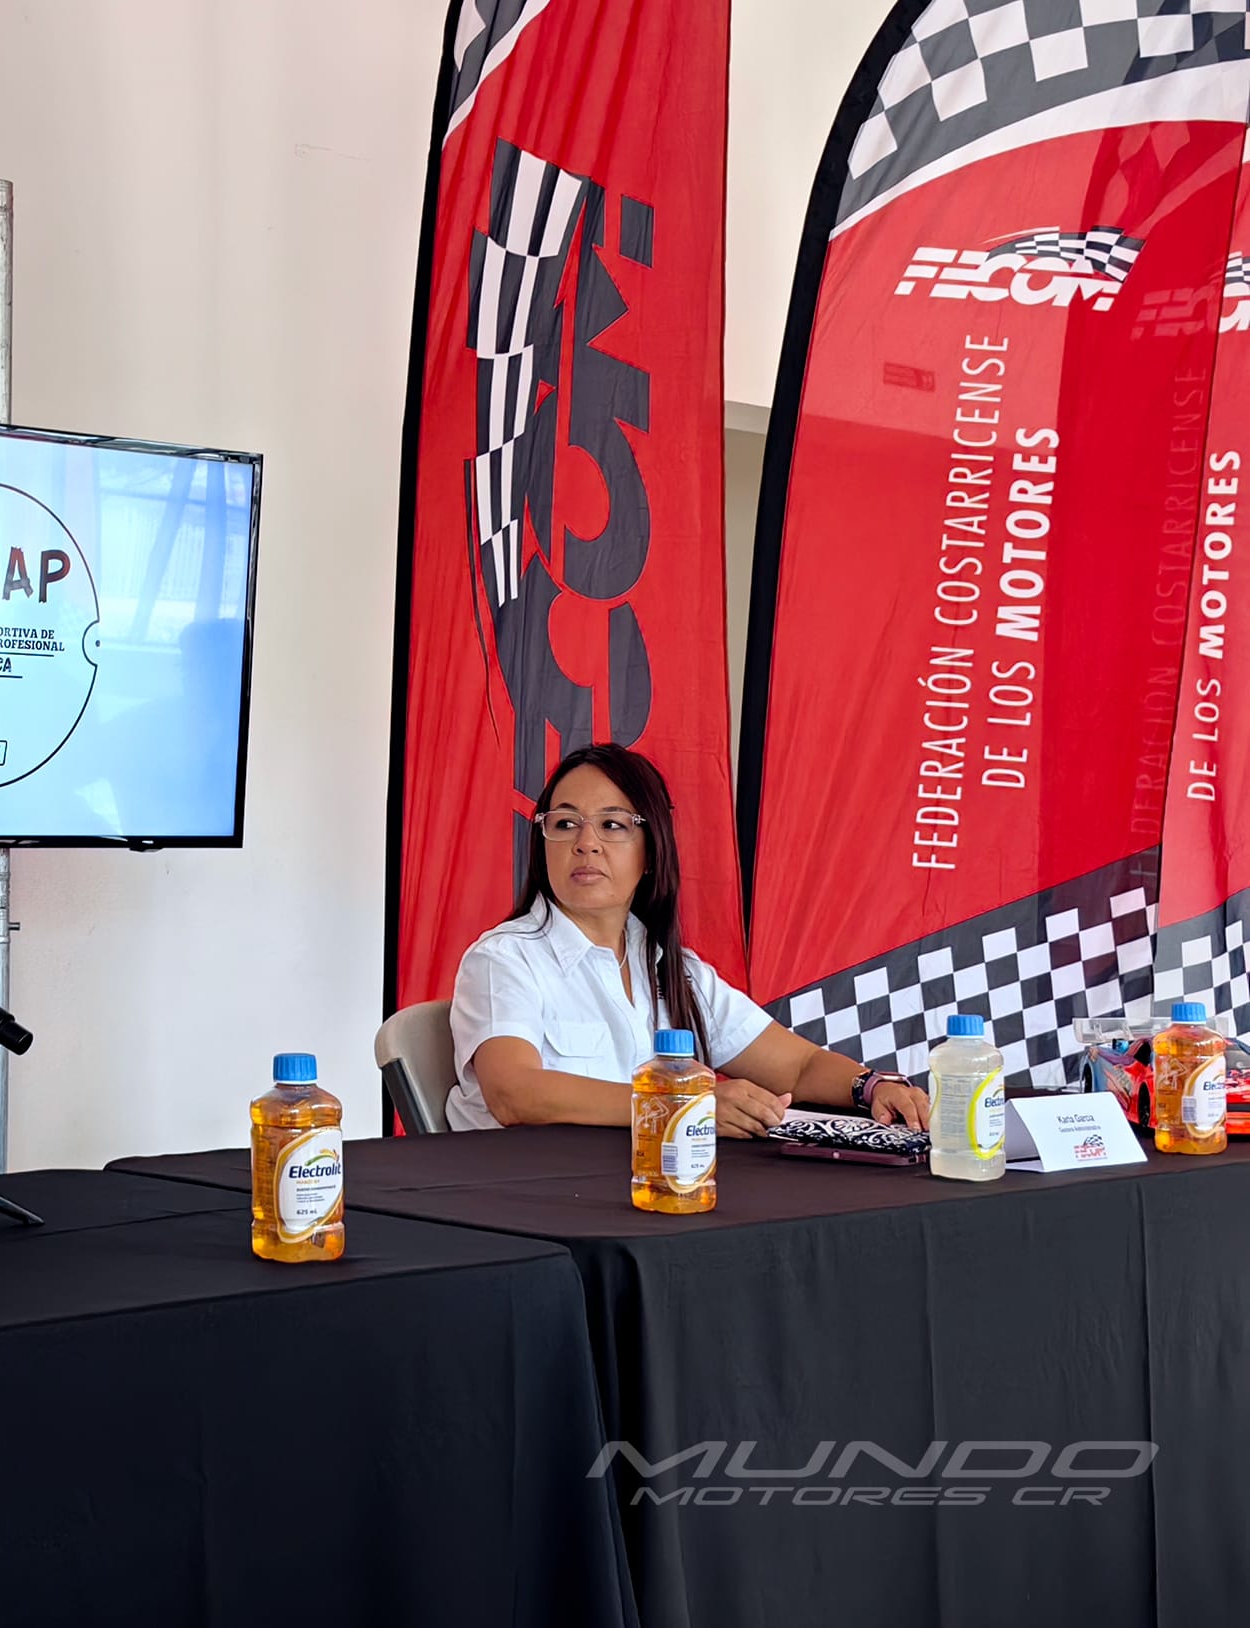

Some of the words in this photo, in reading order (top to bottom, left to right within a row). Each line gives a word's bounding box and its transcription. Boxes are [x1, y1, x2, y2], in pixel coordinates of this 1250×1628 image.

[894, 246, 1123, 312] FECOM
[934, 334, 1009, 625] COSTARRICENSE
[995, 427, 1060, 642] MOTORES
[1198, 450, 1241, 659] MOTORES
[41, 629, 55, 640] DE
[988, 660, 1036, 727] LOS
[1192, 678, 1222, 742] LOS
[912, 645, 976, 870] FEDERACIÓN
[982, 746, 1028, 789] DE
[1186, 759, 1217, 802] DE
[289, 1163, 341, 1179] Electrolit
